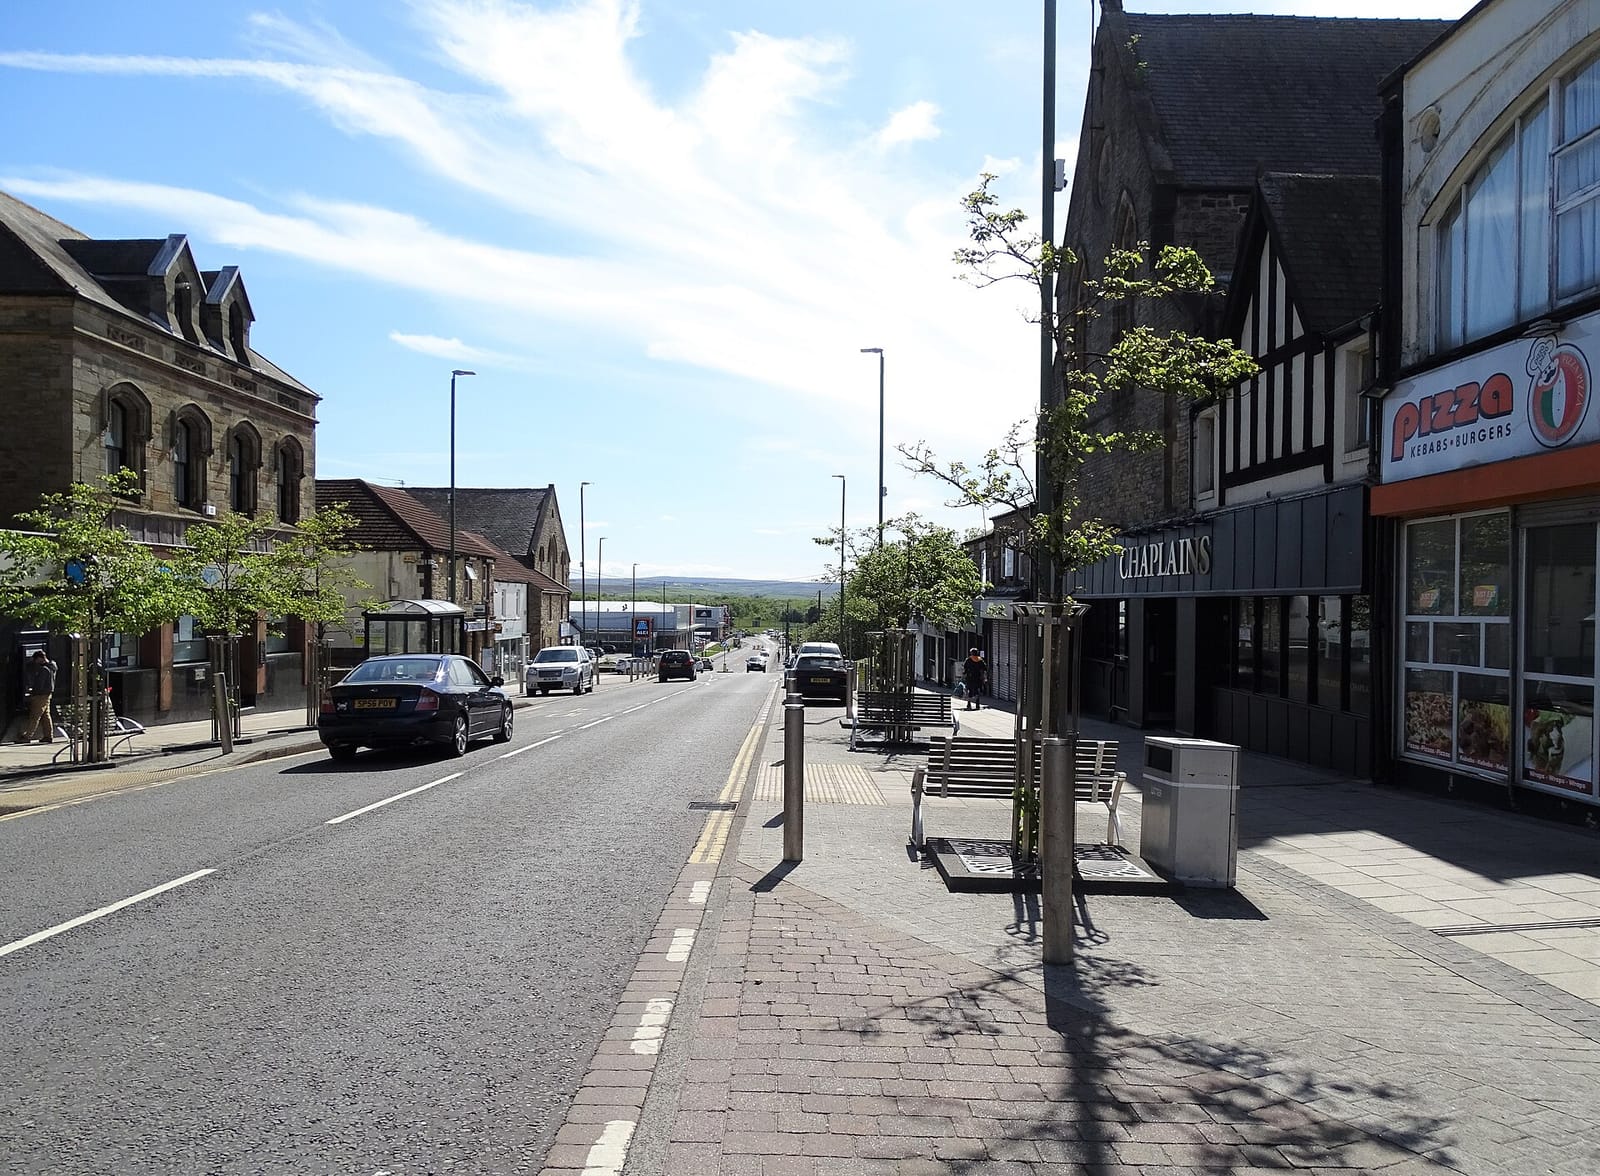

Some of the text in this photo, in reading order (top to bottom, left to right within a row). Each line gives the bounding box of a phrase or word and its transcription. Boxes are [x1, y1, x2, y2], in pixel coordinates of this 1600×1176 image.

[1410, 438, 1448, 459] KEBABS
[1455, 422, 1512, 448] BURGERS
[1120, 535, 1210, 580] CHAPLAINS
